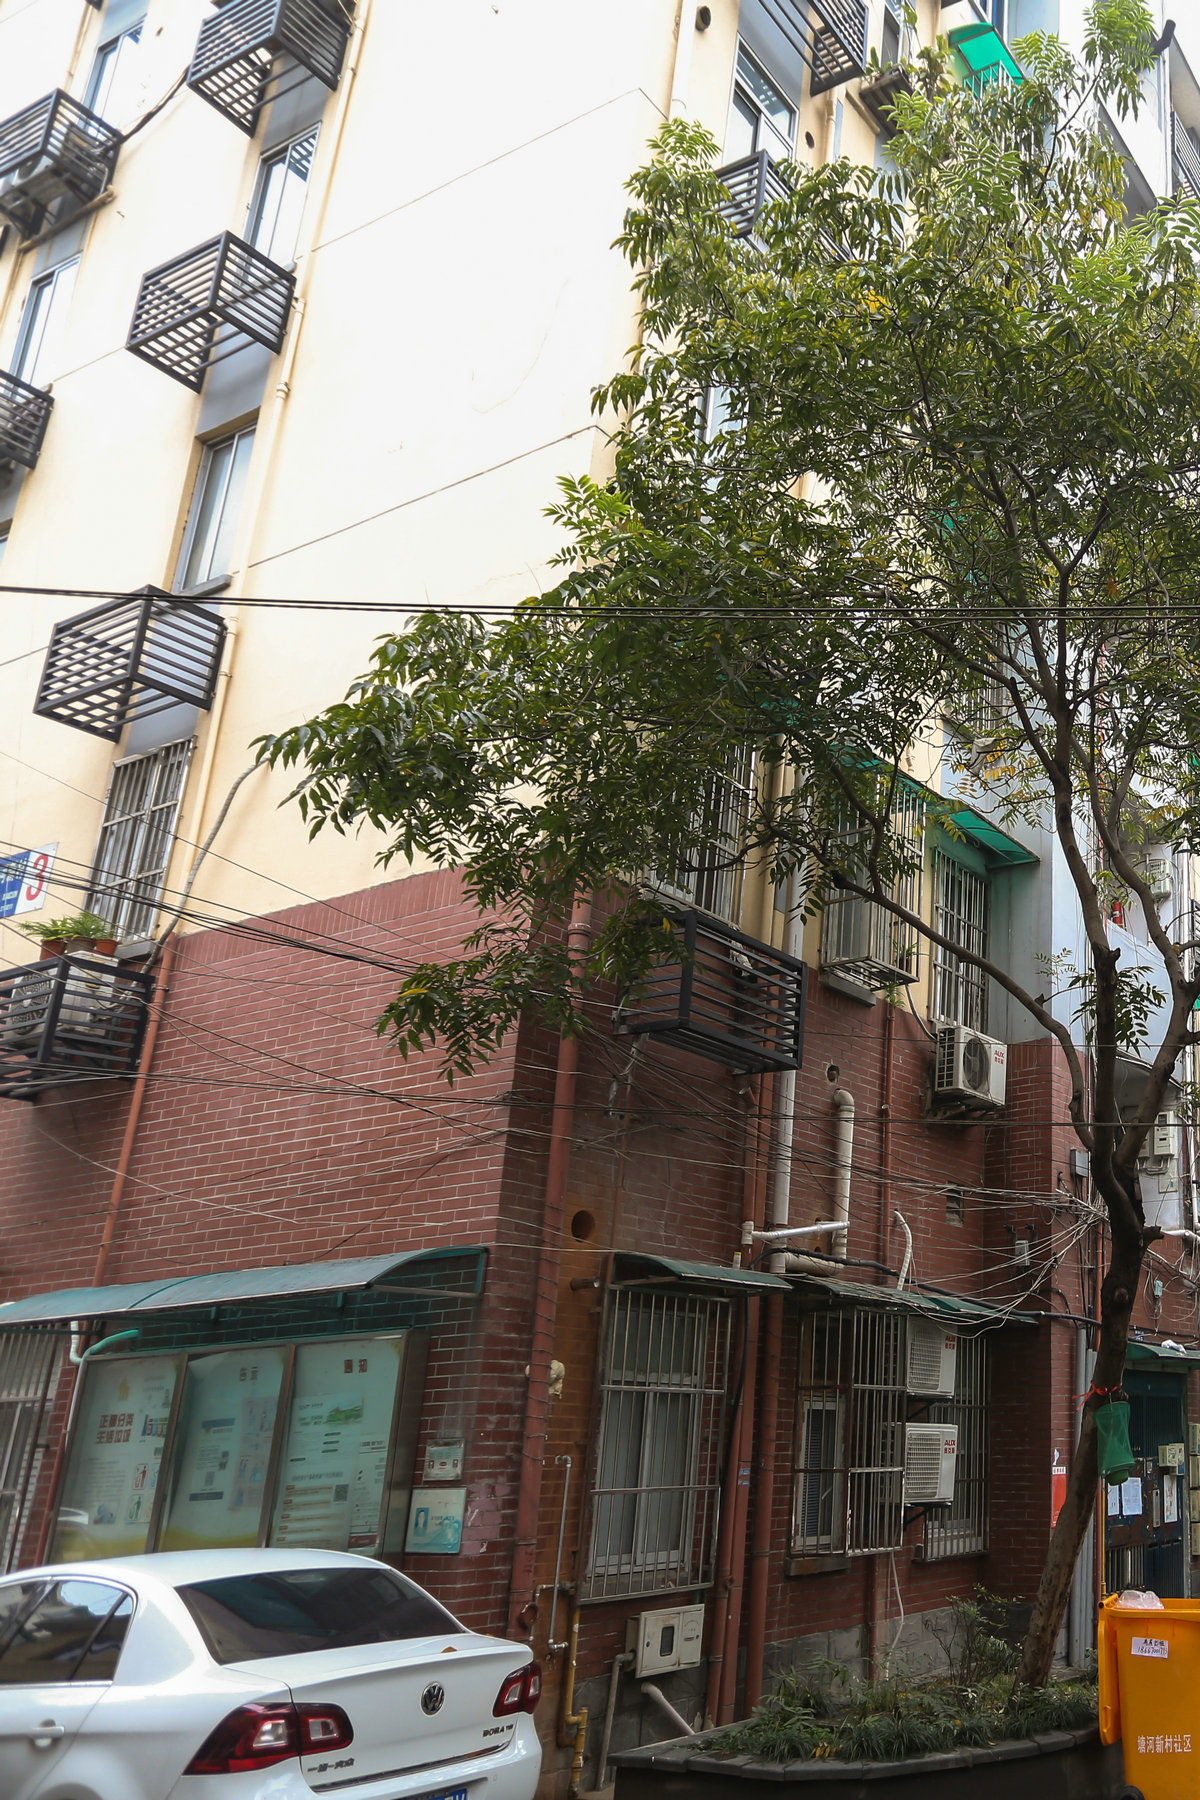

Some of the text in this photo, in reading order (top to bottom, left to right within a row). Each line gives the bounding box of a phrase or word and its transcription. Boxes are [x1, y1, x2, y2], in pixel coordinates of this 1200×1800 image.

[26, 854, 49, 901] 3
[1137, 1734, 1193, 1754] 塘河新村社区
